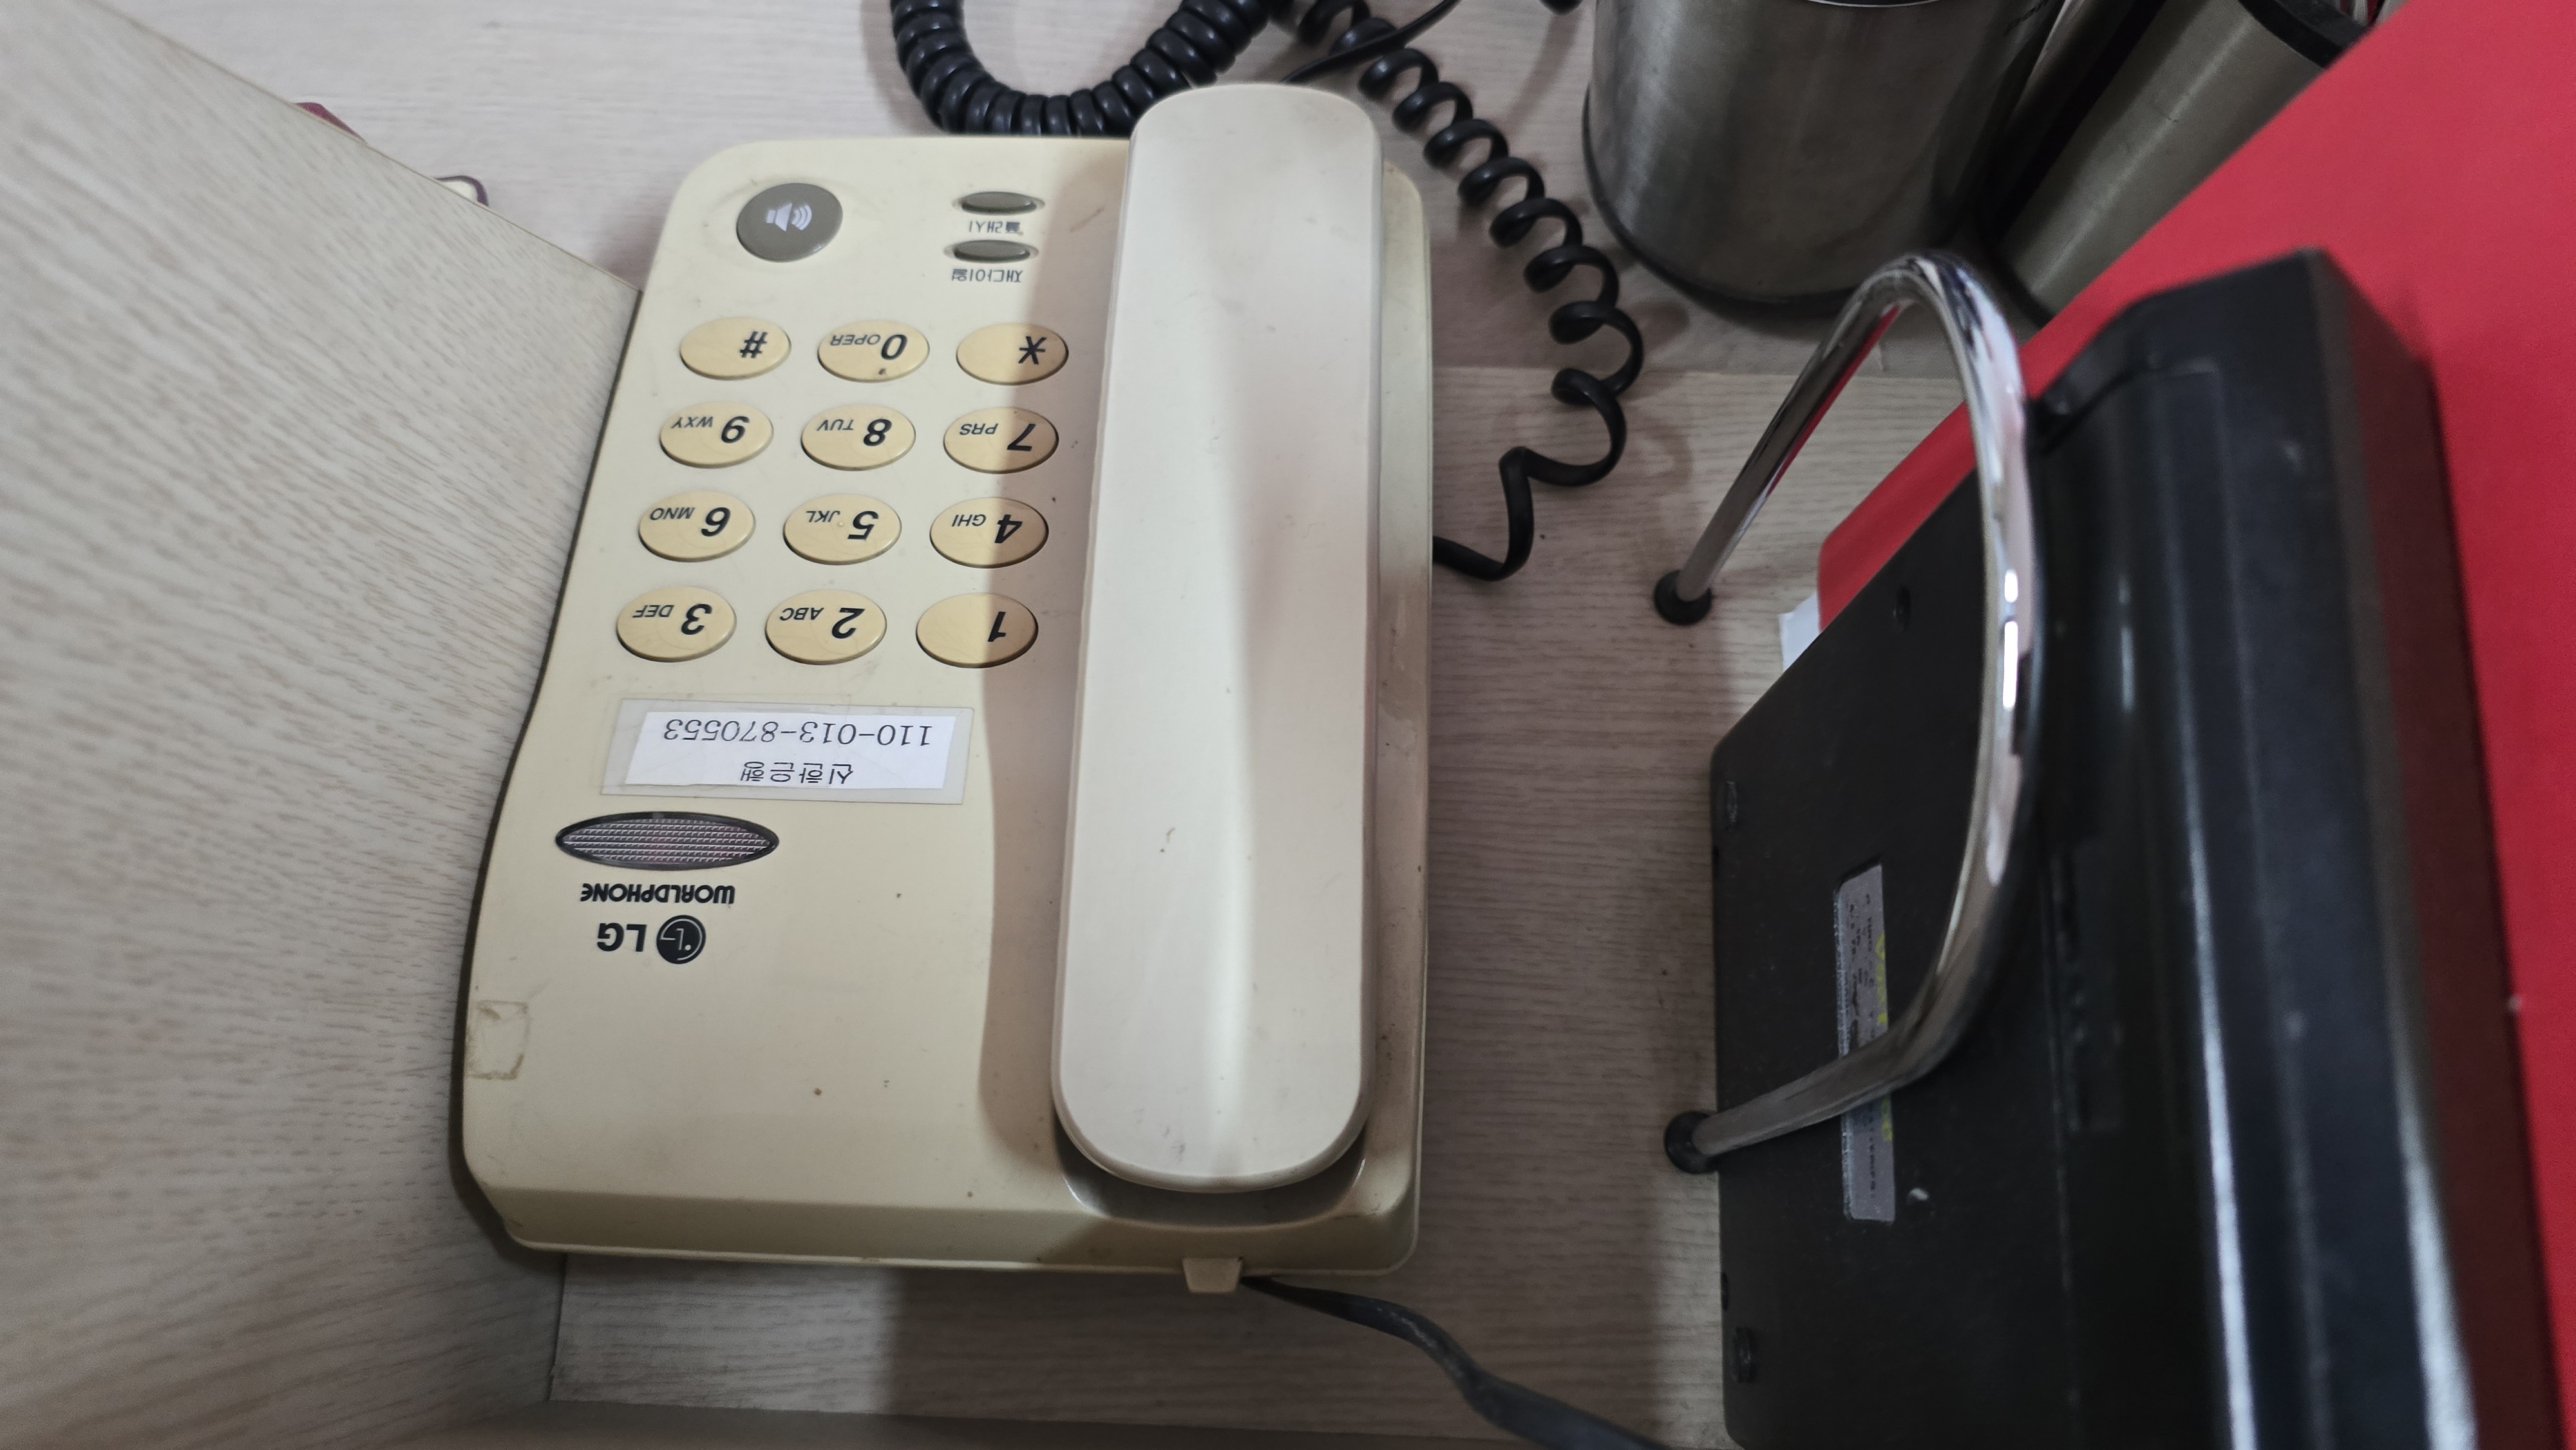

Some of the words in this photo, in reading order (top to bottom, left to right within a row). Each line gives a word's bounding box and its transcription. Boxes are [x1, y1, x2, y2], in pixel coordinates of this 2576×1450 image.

[952, 268, 1023, 283] 재다이얼
[830, 333, 880, 346] OPER
[880, 334, 908, 360] 0
[670, 415, 714, 429] WXY
[721, 415, 751, 443] 9
[817, 418, 855, 431] TUV
[863, 418, 893, 446] 8
[959, 422, 999, 436] PRS
[1007, 422, 1036, 451] 7
[649, 506, 696, 522] MNO
[701, 506, 732, 537] 6
[805, 509, 841, 524] JKL
[848, 510, 880, 541] 5
[951, 513, 987, 527] GHI
[993, 513, 1024, 545] 4
[632, 604, 675, 619] DEF
[679, 603, 714, 636] 3
[779, 606, 825, 623] ABC
[831, 607, 866, 640] 2
[985, 610, 1010, 643] 1
[663, 719, 933, 746] 110-013-870553
[739, 761, 854, 785] 신한은행
[580, 883, 735, 905] WORLDPHONE
[597, 922, 647, 952] LG
